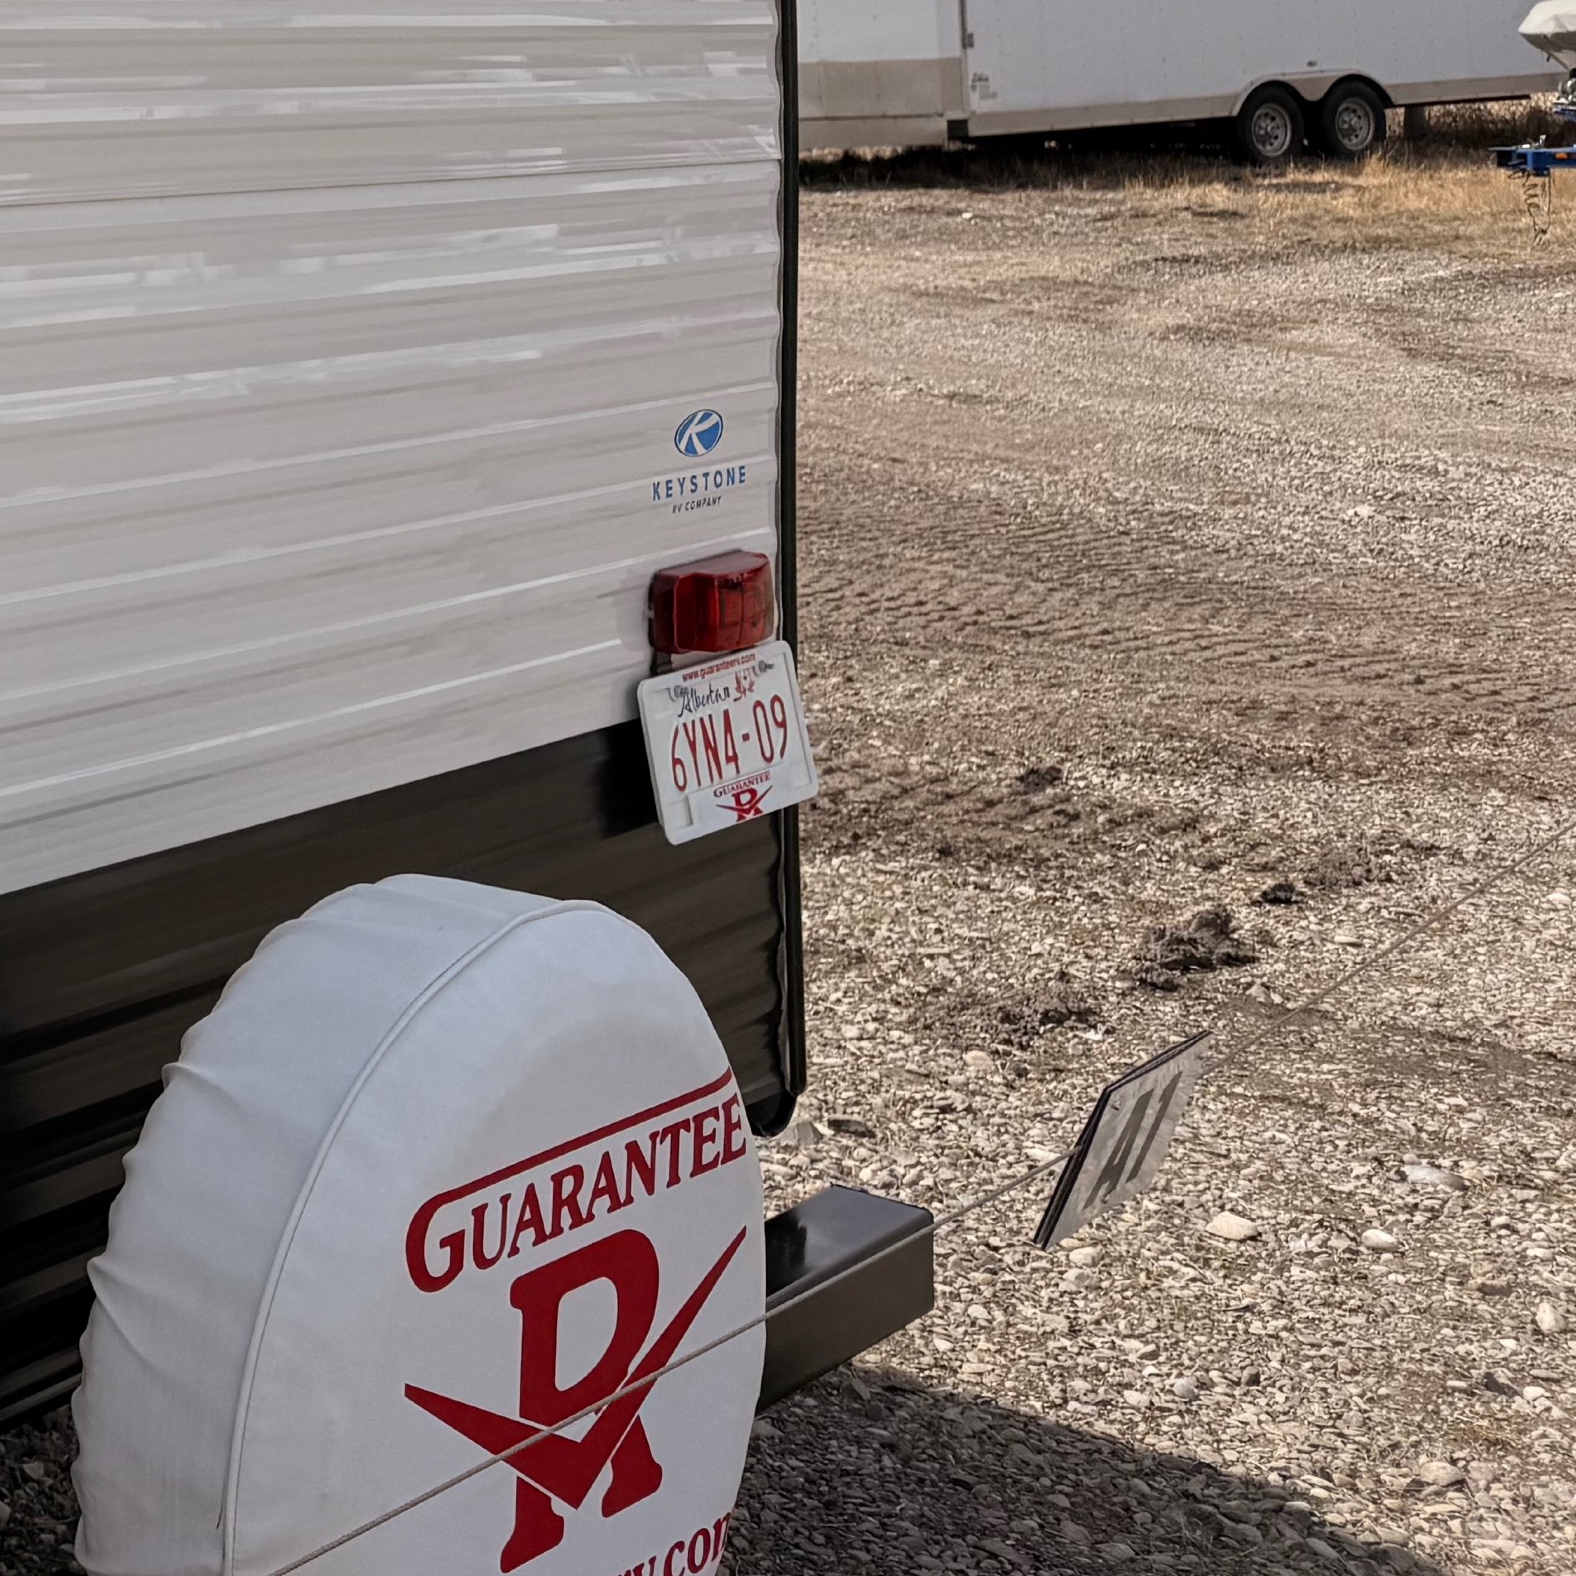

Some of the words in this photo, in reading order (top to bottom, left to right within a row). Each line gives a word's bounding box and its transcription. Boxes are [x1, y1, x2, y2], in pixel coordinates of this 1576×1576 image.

[652, 465, 746, 501] KEYSTONE
[672, 503, 683, 514] RV
[684, 496, 722, 511] COMPANY
[670, 694, 788, 793] 6YN4-09
